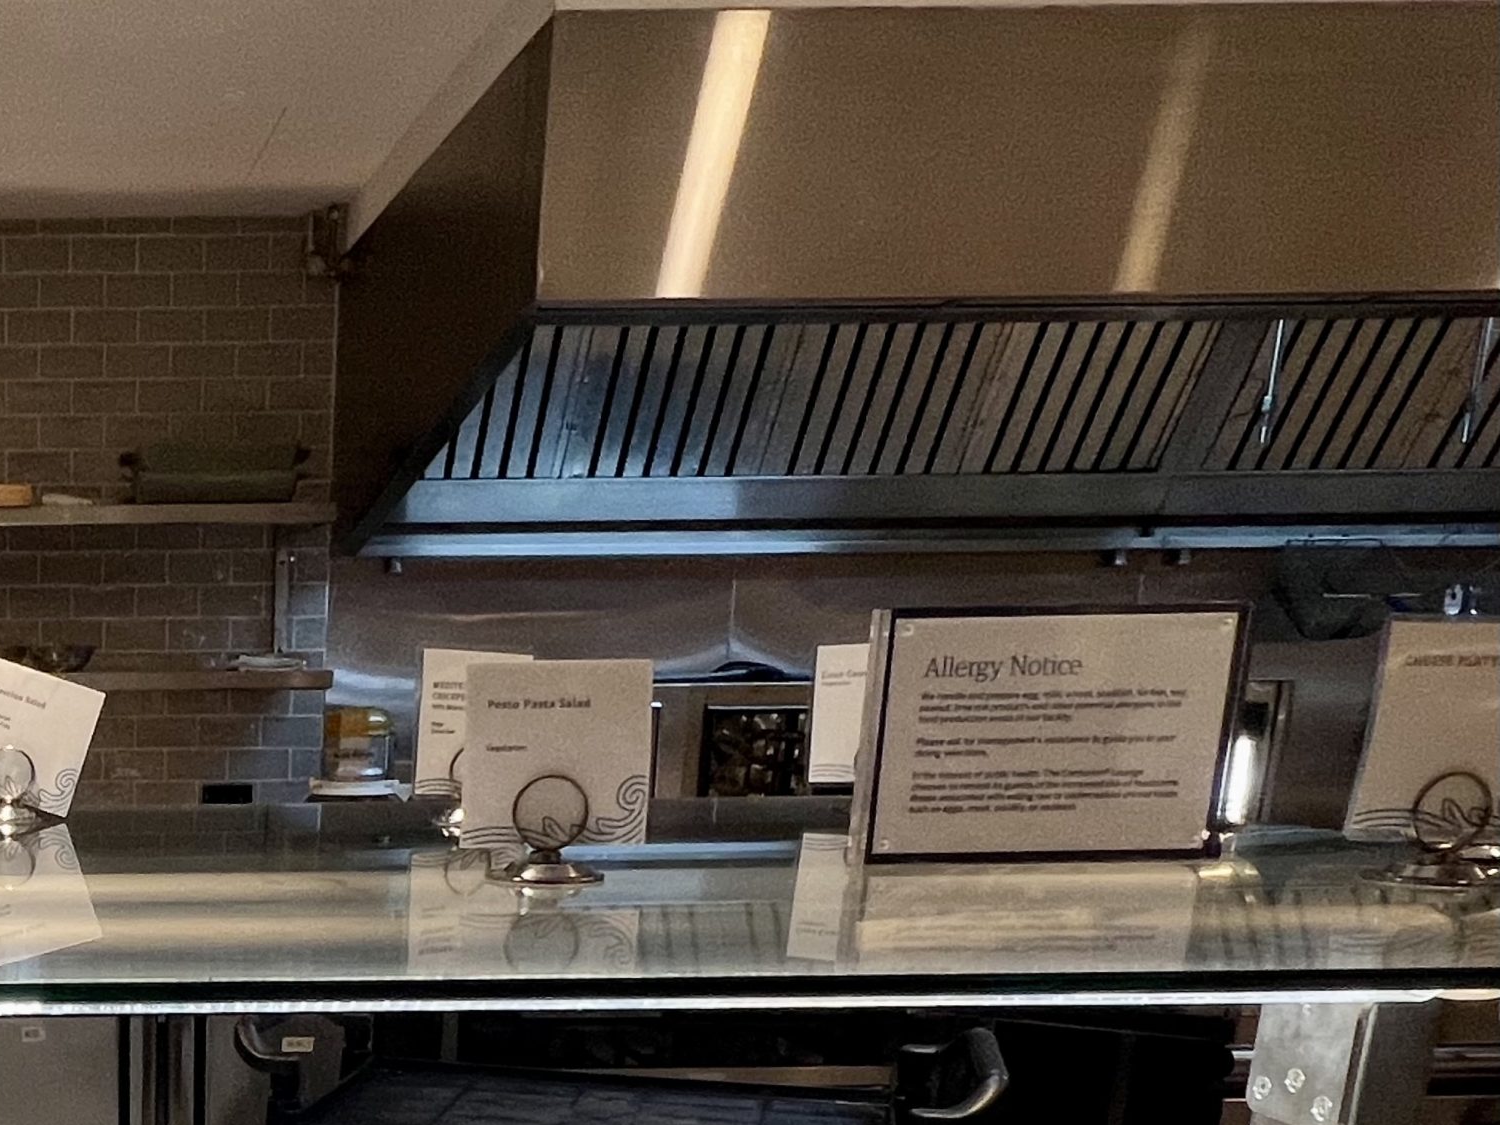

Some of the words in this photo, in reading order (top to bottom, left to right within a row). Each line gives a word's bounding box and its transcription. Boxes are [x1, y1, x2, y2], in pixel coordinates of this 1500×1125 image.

[923, 655, 1003, 683] Allergy
[1009, 654, 1084, 677] Notice
[486, 699, 520, 710] Pesto
[523, 698, 556, 710] Pasta
[558, 696, 591, 709] Salad
